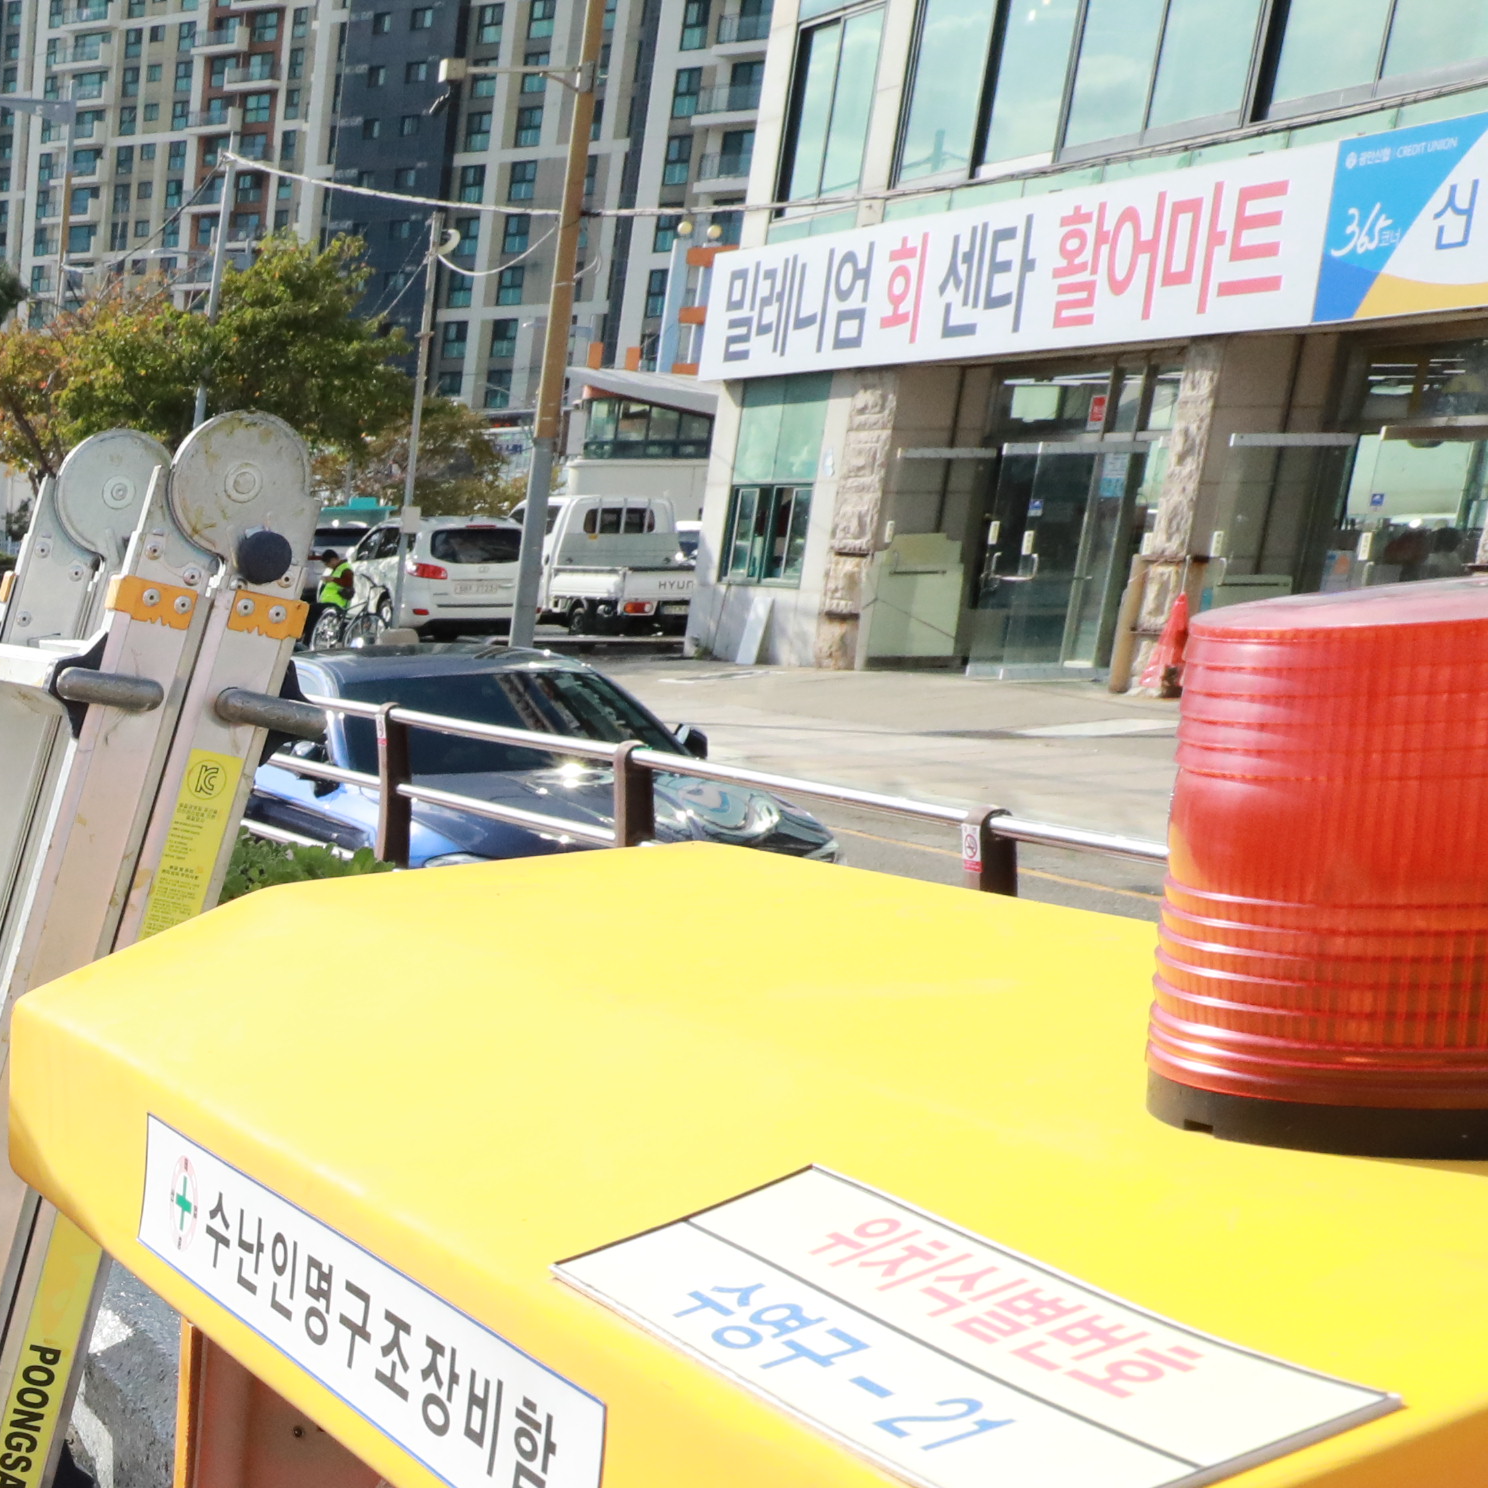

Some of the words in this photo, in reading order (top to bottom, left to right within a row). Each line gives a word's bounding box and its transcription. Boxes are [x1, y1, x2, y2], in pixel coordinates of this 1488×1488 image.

[1396, 142, 1425, 158] CREDIT
[1426, 137, 1458, 153] UNION
[723, 241, 877, 363] 밀레니엄
[879, 232, 929, 344] 회
[939, 214, 1036, 339] 센타
[1053, 179, 1290, 329] 활어마트
[1331, 202, 1393, 257] 365
[1433, 179, 1479, 250] 신
[672, 1280, 872, 1370] 수영구
[873, 1397, 1017, 1452] 21
[810, 1216, 1204, 1398] 위치식별번호
